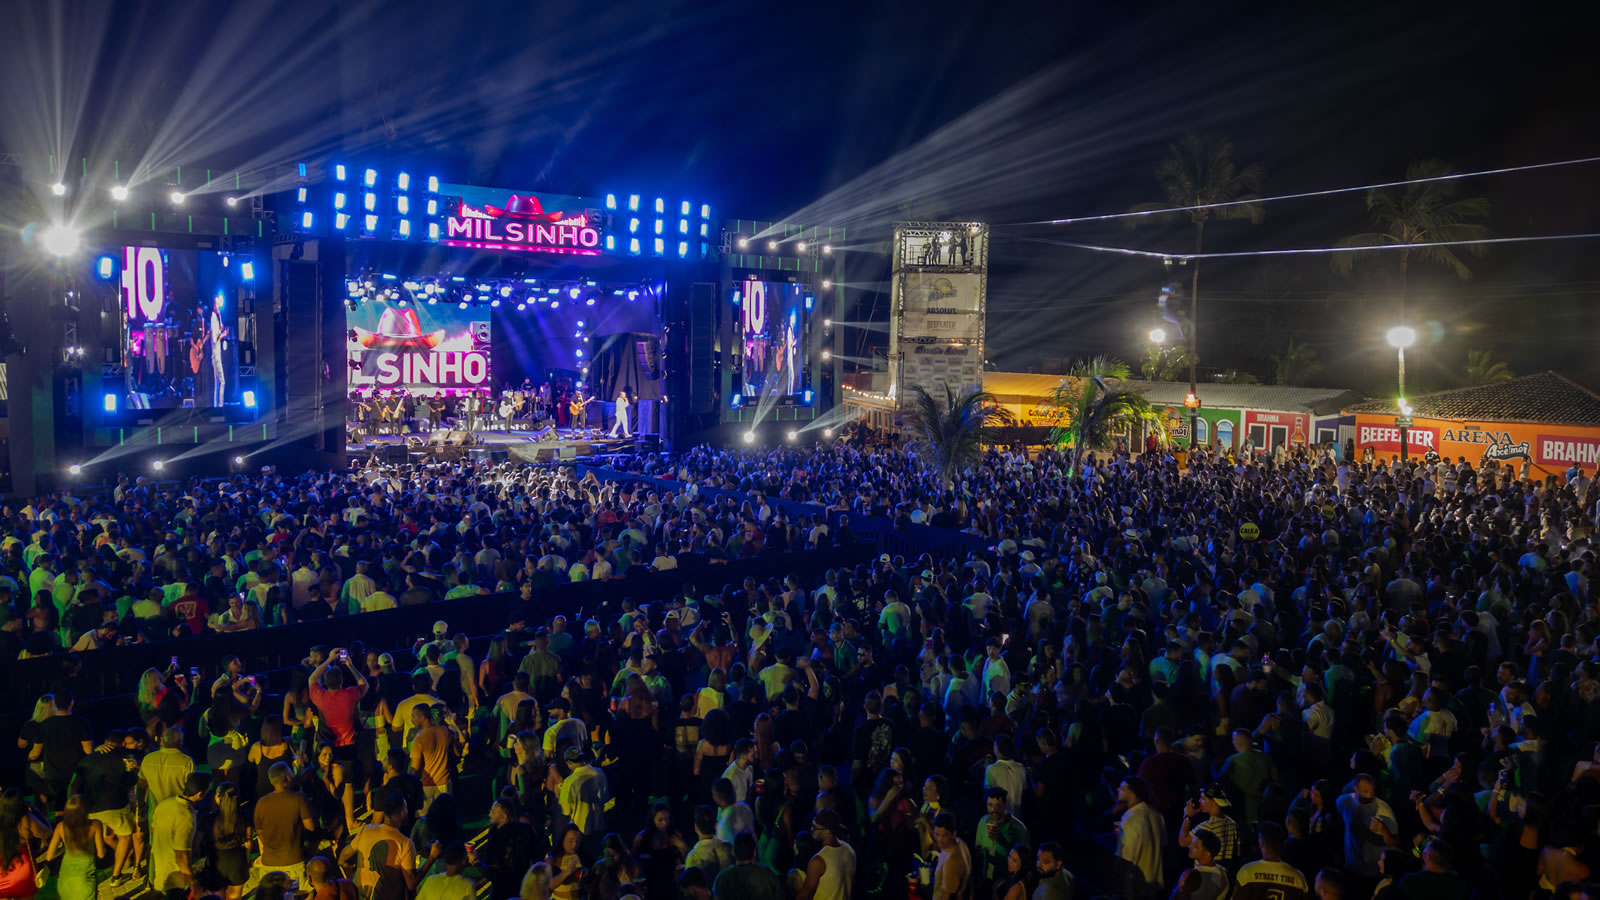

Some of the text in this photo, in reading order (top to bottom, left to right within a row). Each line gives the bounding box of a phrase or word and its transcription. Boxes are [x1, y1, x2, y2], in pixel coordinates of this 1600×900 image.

[448, 217, 599, 247] MILSINHO
[1256, 413, 1280, 423] BRAHMA
[1360, 426, 1434, 449] BEEFETER
[1442, 428, 1515, 445] ARENA
